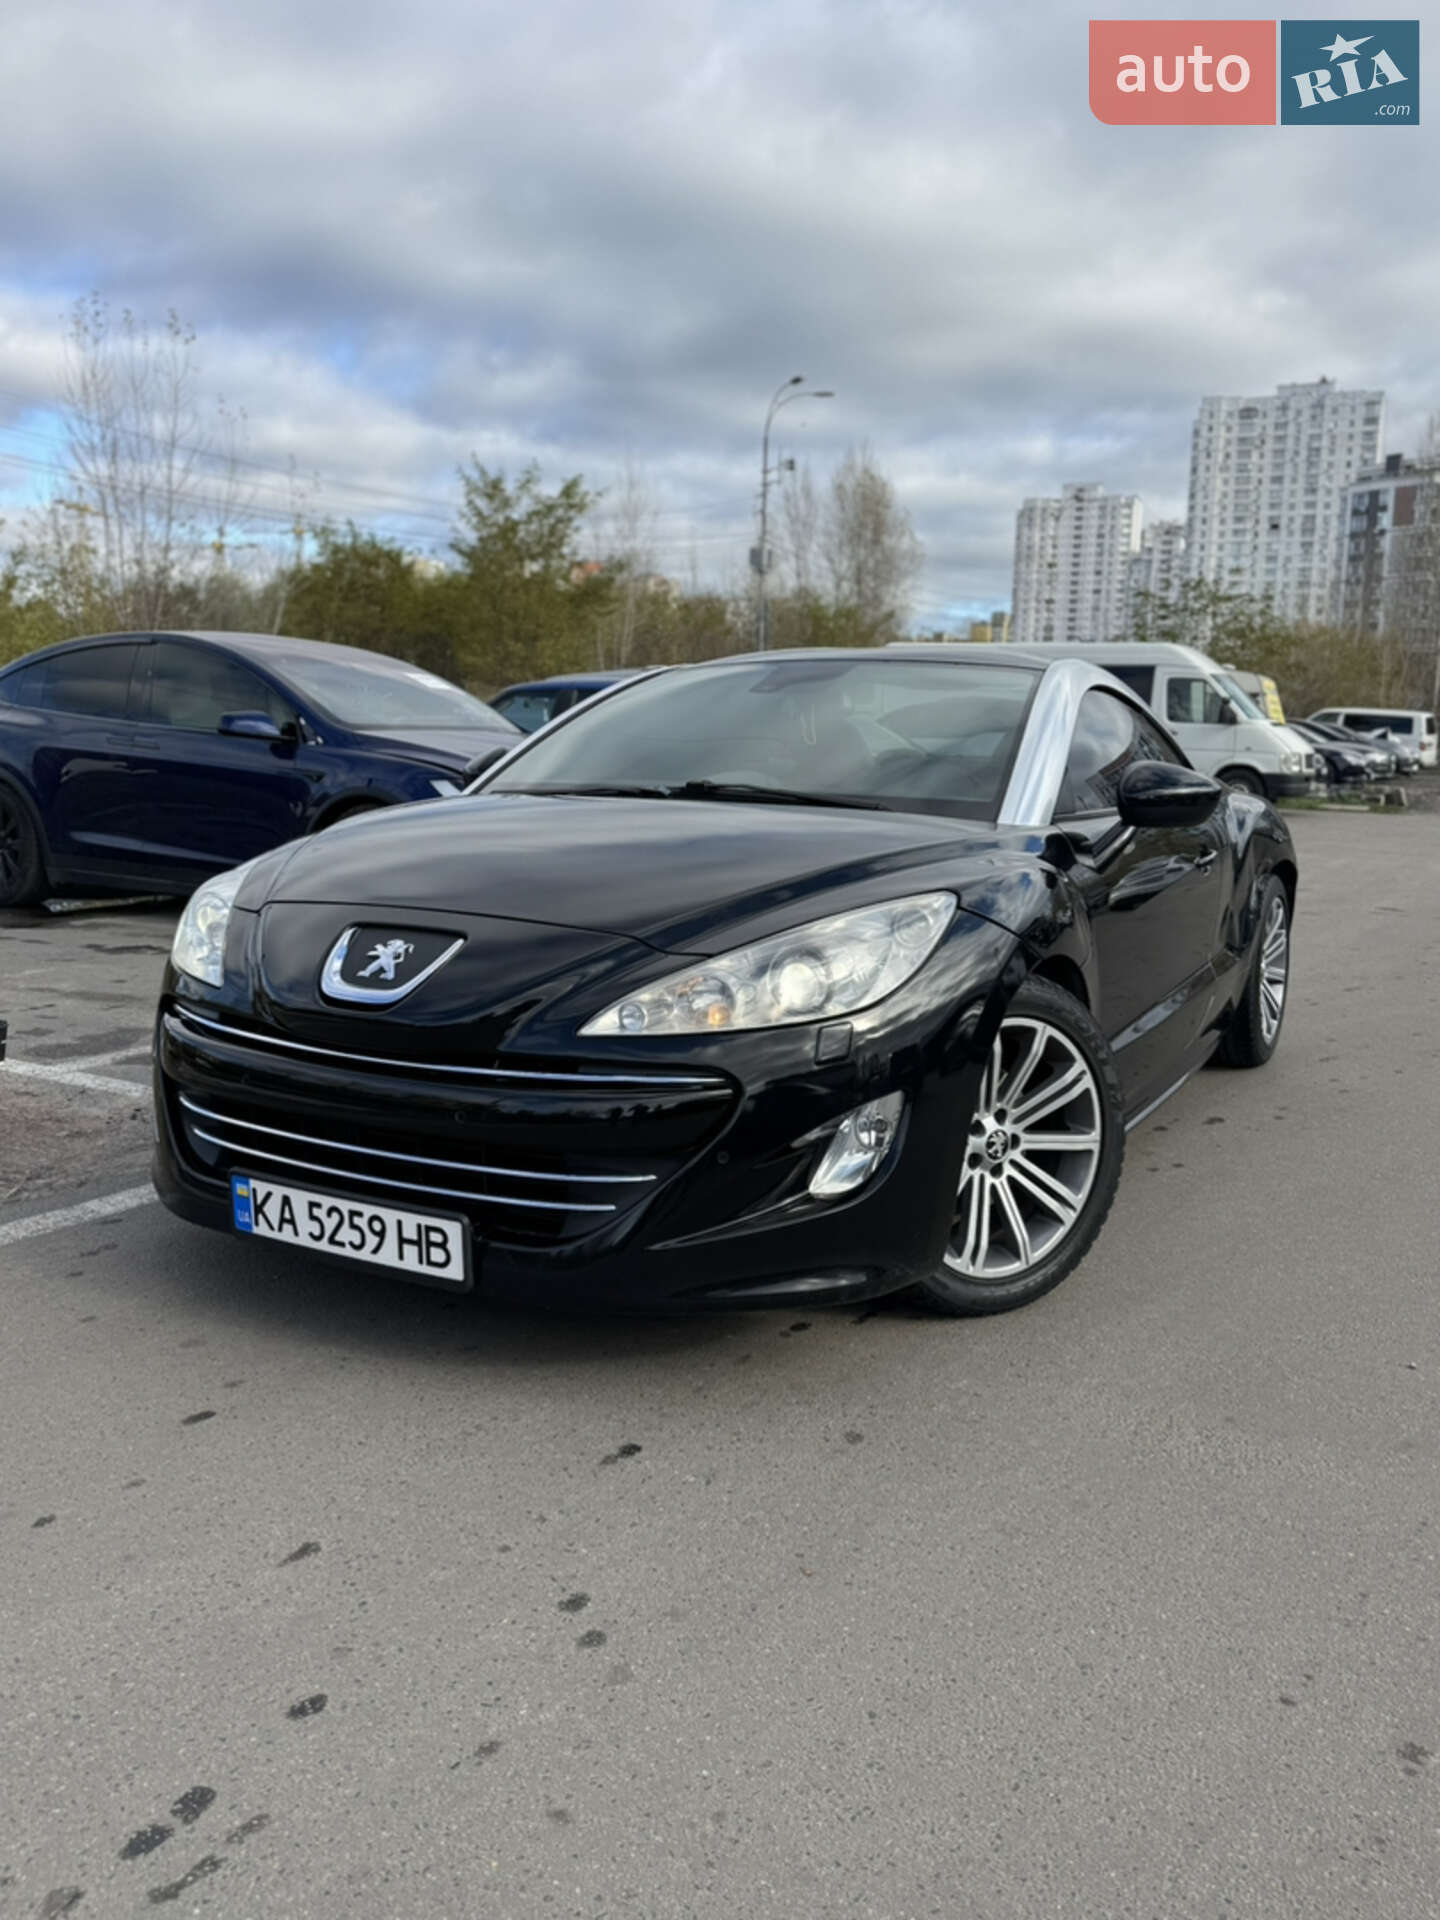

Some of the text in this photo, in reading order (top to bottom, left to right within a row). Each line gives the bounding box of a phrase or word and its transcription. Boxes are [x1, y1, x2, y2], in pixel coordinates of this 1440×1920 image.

[251, 1186, 452, 1270] KA 5259 HB
